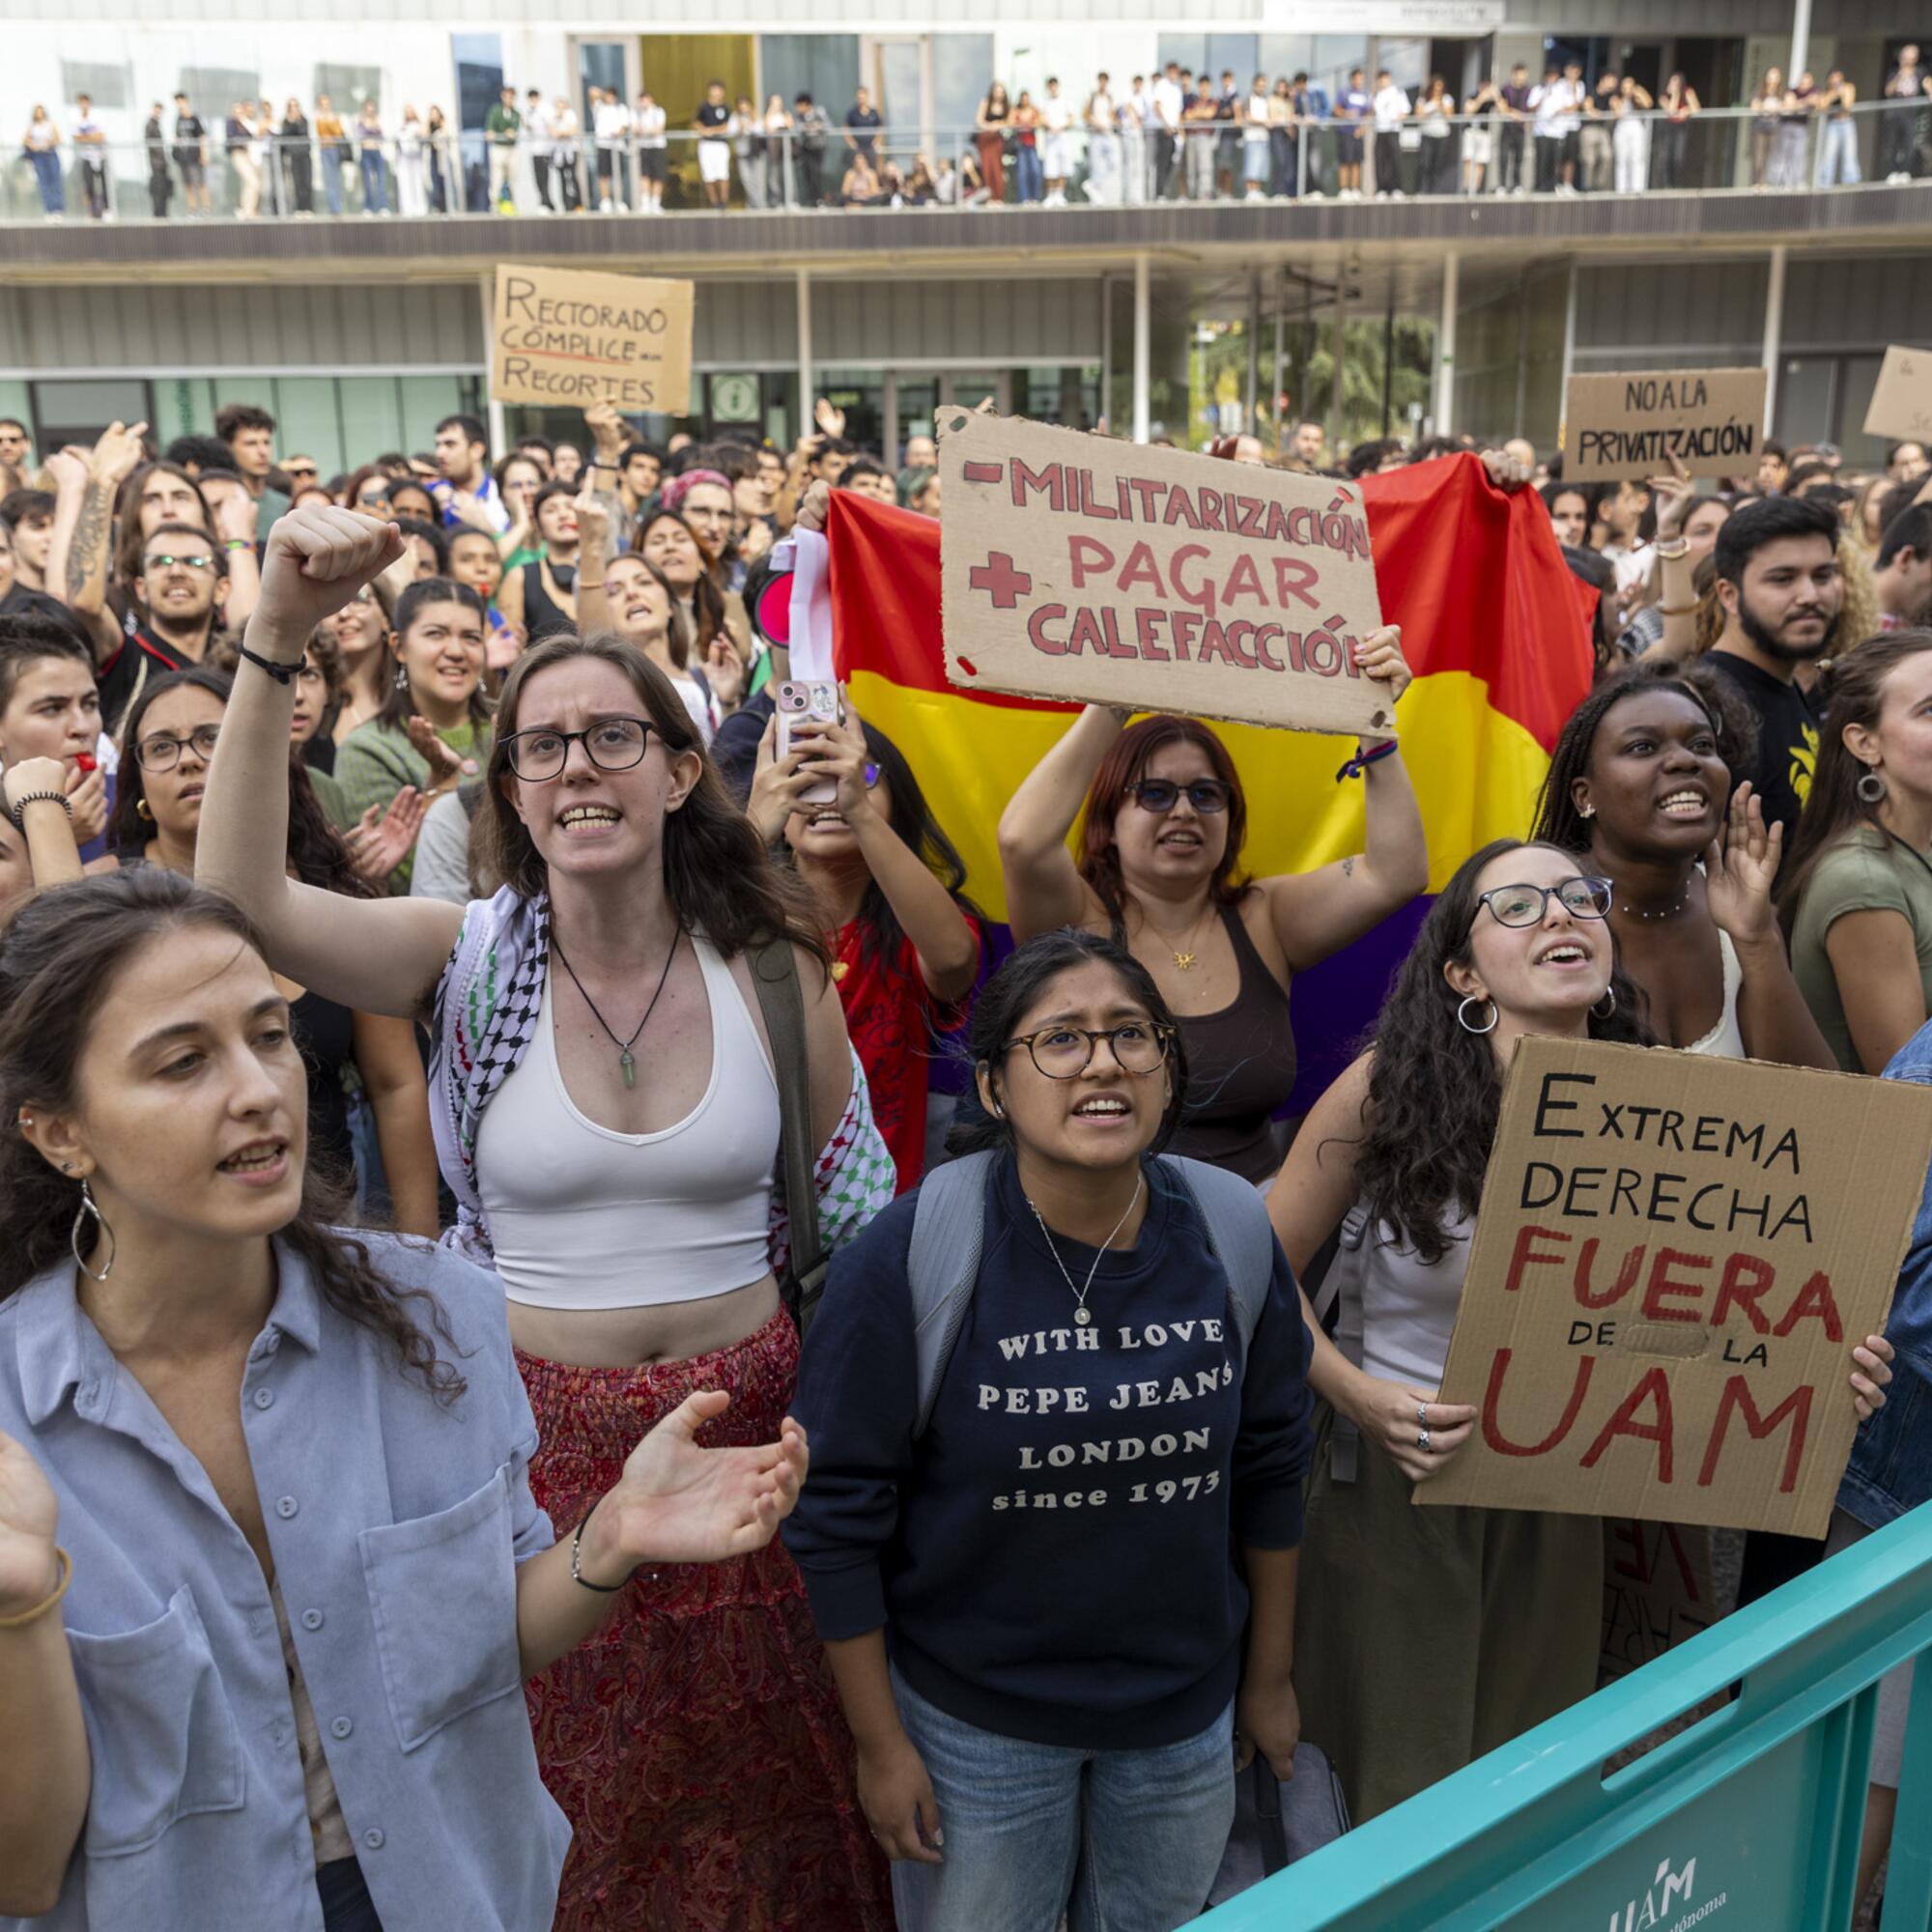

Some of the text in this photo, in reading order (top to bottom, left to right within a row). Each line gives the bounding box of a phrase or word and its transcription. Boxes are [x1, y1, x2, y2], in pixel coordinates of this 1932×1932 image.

[505, 277, 668, 334] RECTORADO
[503, 356, 655, 405] RECORTES
[1626, 379, 1708, 412] NO A LA
[1578, 415, 1753, 465] PRIVATIZACIÓN
[1067, 535, 1321, 618] PAGAR
[1533, 1072, 1801, 1175] EXTREMA
[1520, 1161, 1813, 1243] DERECHA
[1505, 1225, 1843, 1343] FUERA
[998, 1319, 1224, 1361] WITH LOVE
[1567, 1321, 1767, 1368] DE LA
[977, 1384, 1090, 1414] PEPE
[1481, 1348, 1814, 1493] UAM
[1019, 1427, 1210, 1469] LONDON
[992, 1469, 1220, 1511] since 1973
[1669, 1891, 1726, 1932] tónoma
